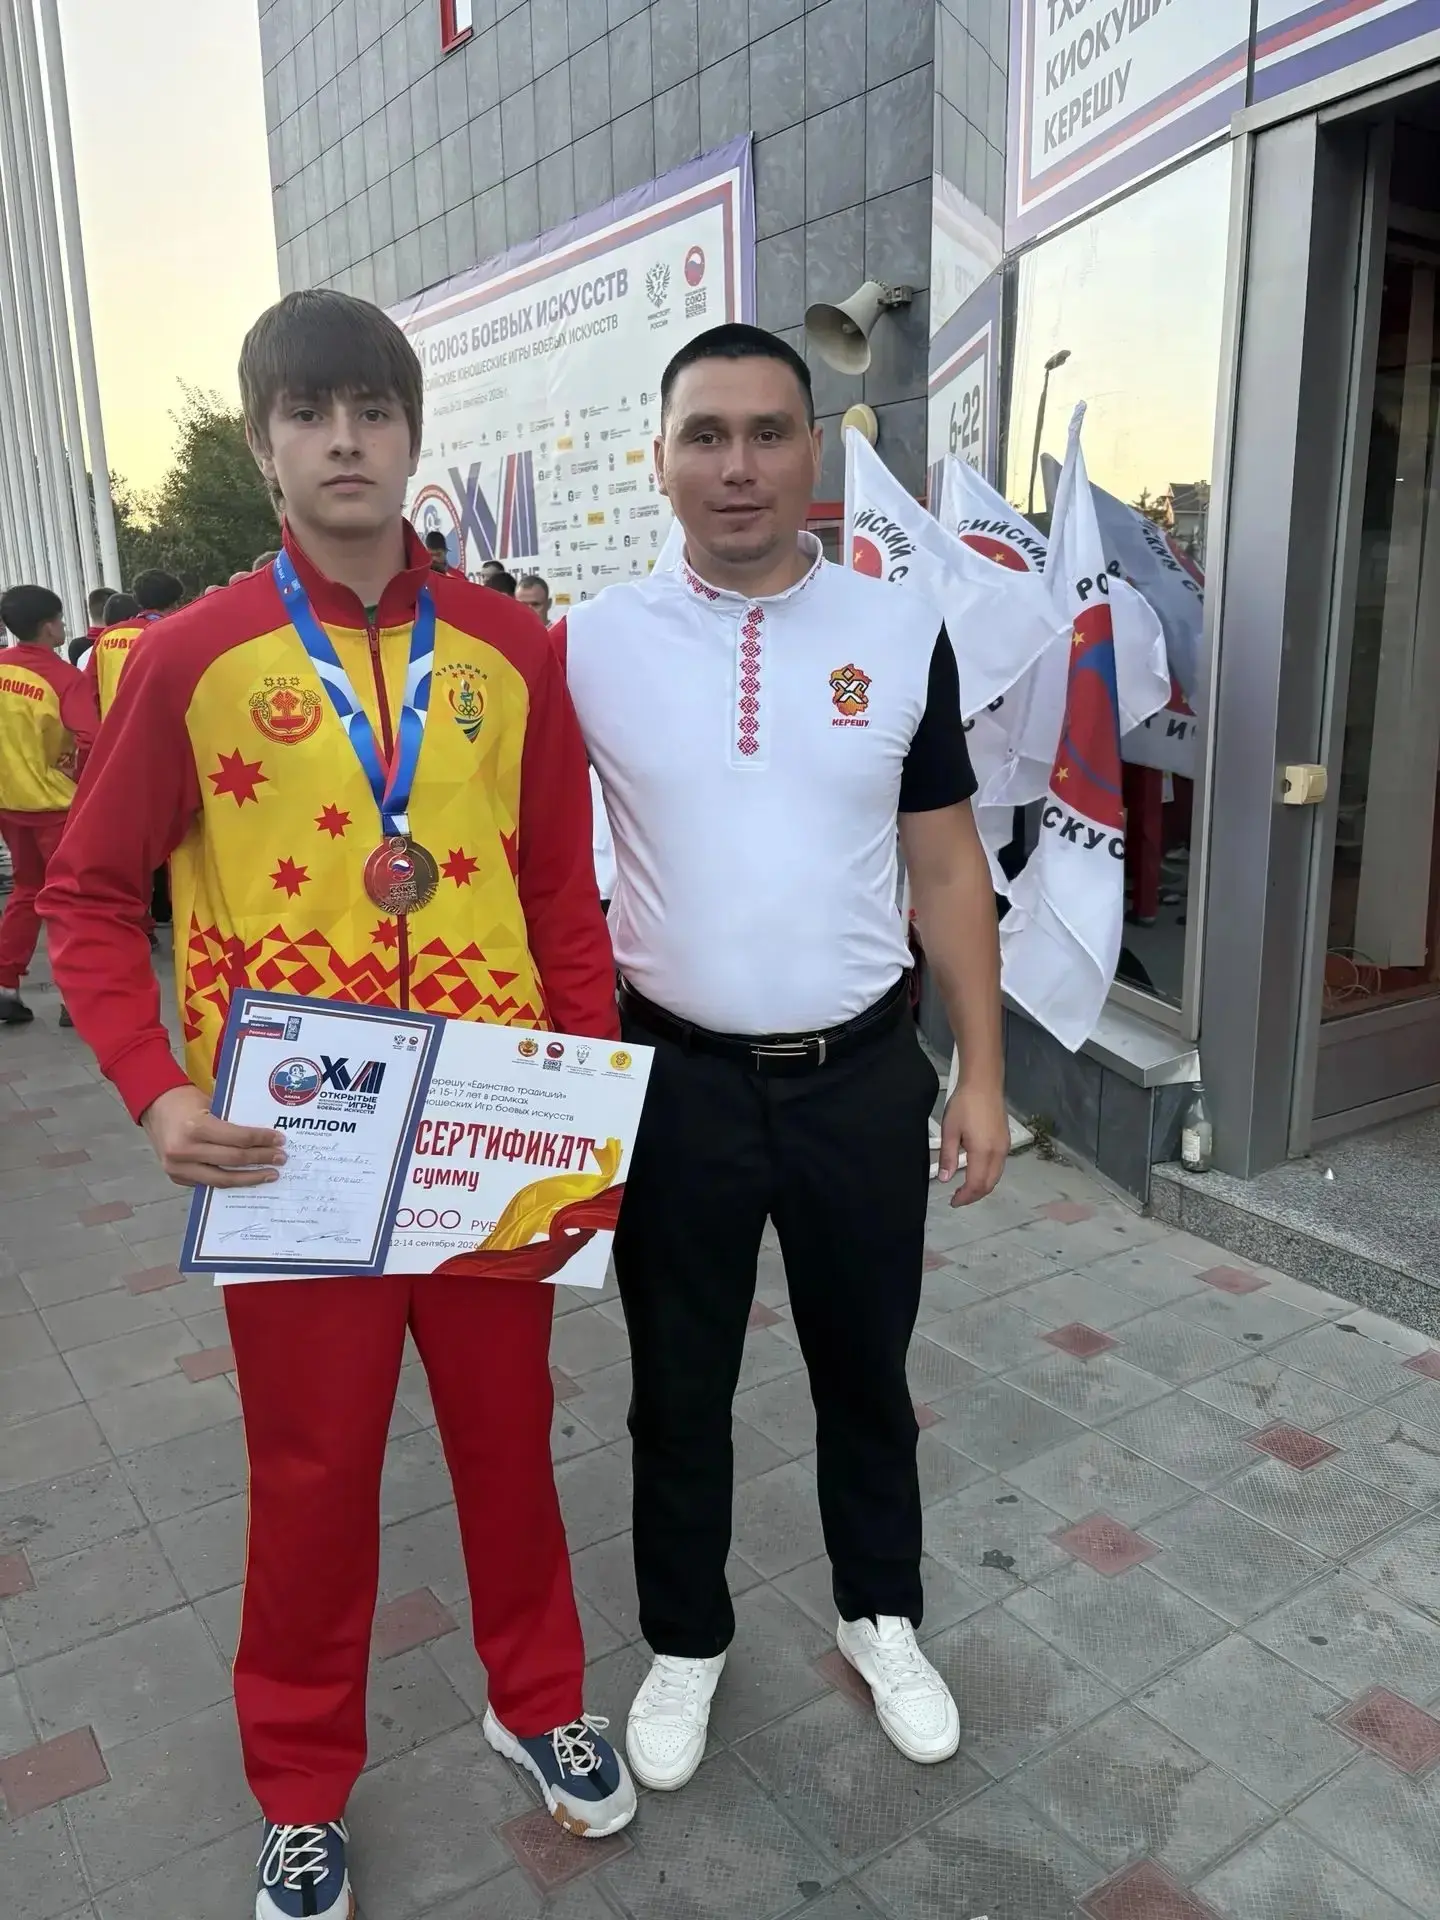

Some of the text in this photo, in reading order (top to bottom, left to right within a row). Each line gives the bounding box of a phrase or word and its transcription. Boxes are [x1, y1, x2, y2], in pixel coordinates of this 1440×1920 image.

[1047, 0, 1092, 36] ТХ
[1044, 58, 1133, 155] КЕРЕШУ
[429, 333, 468, 367] СОЮЗ
[471, 306, 533, 352] БОЕВЫХ
[536, 267, 629, 327] ИСКУССТВ
[458, 354, 508, 382] ЮНОШЕСКИЕ
[508, 346, 531, 366] ИГРЫ
[531, 334, 569, 356] БОЕВЫХ
[569, 313, 620, 345] ИСКУССТВ
[949, 385, 980, 454] 6-22
[853, 508, 917, 586] ЙСКИЙ С
[434, 663, 488, 681] ЧУВАШИЯ
[0, 676, 45, 702] АШИЯ
[831, 717, 870, 728] КЕРЕШУ
[1042, 806, 1125, 861] СКУС
[319, 1091, 378, 1103] ОТКРЫТЫЕ
[431, 1077, 567, 1099] ерешу «Единство традиций»
[439, 1088, 463, 1097] 15-17
[490, 1094, 529, 1105] рамках
[344, 1107, 375, 1115] ИСКУССТВ
[348, 1101, 376, 1110] ИГРЫ
[474, 1102, 493, 1112] Игр
[495, 1104, 530, 1115] боевых
[531, 1109, 575, 1122] искусств
[273, 1116, 357, 1134] ДИПЛОМ
[414, 1119, 596, 1171] СЕРТИФИКАТ
[412, 1167, 480, 1192] сумму
[415, 1240, 456, 1249] сентября
[457, 1240, 480, 1249] 2026
